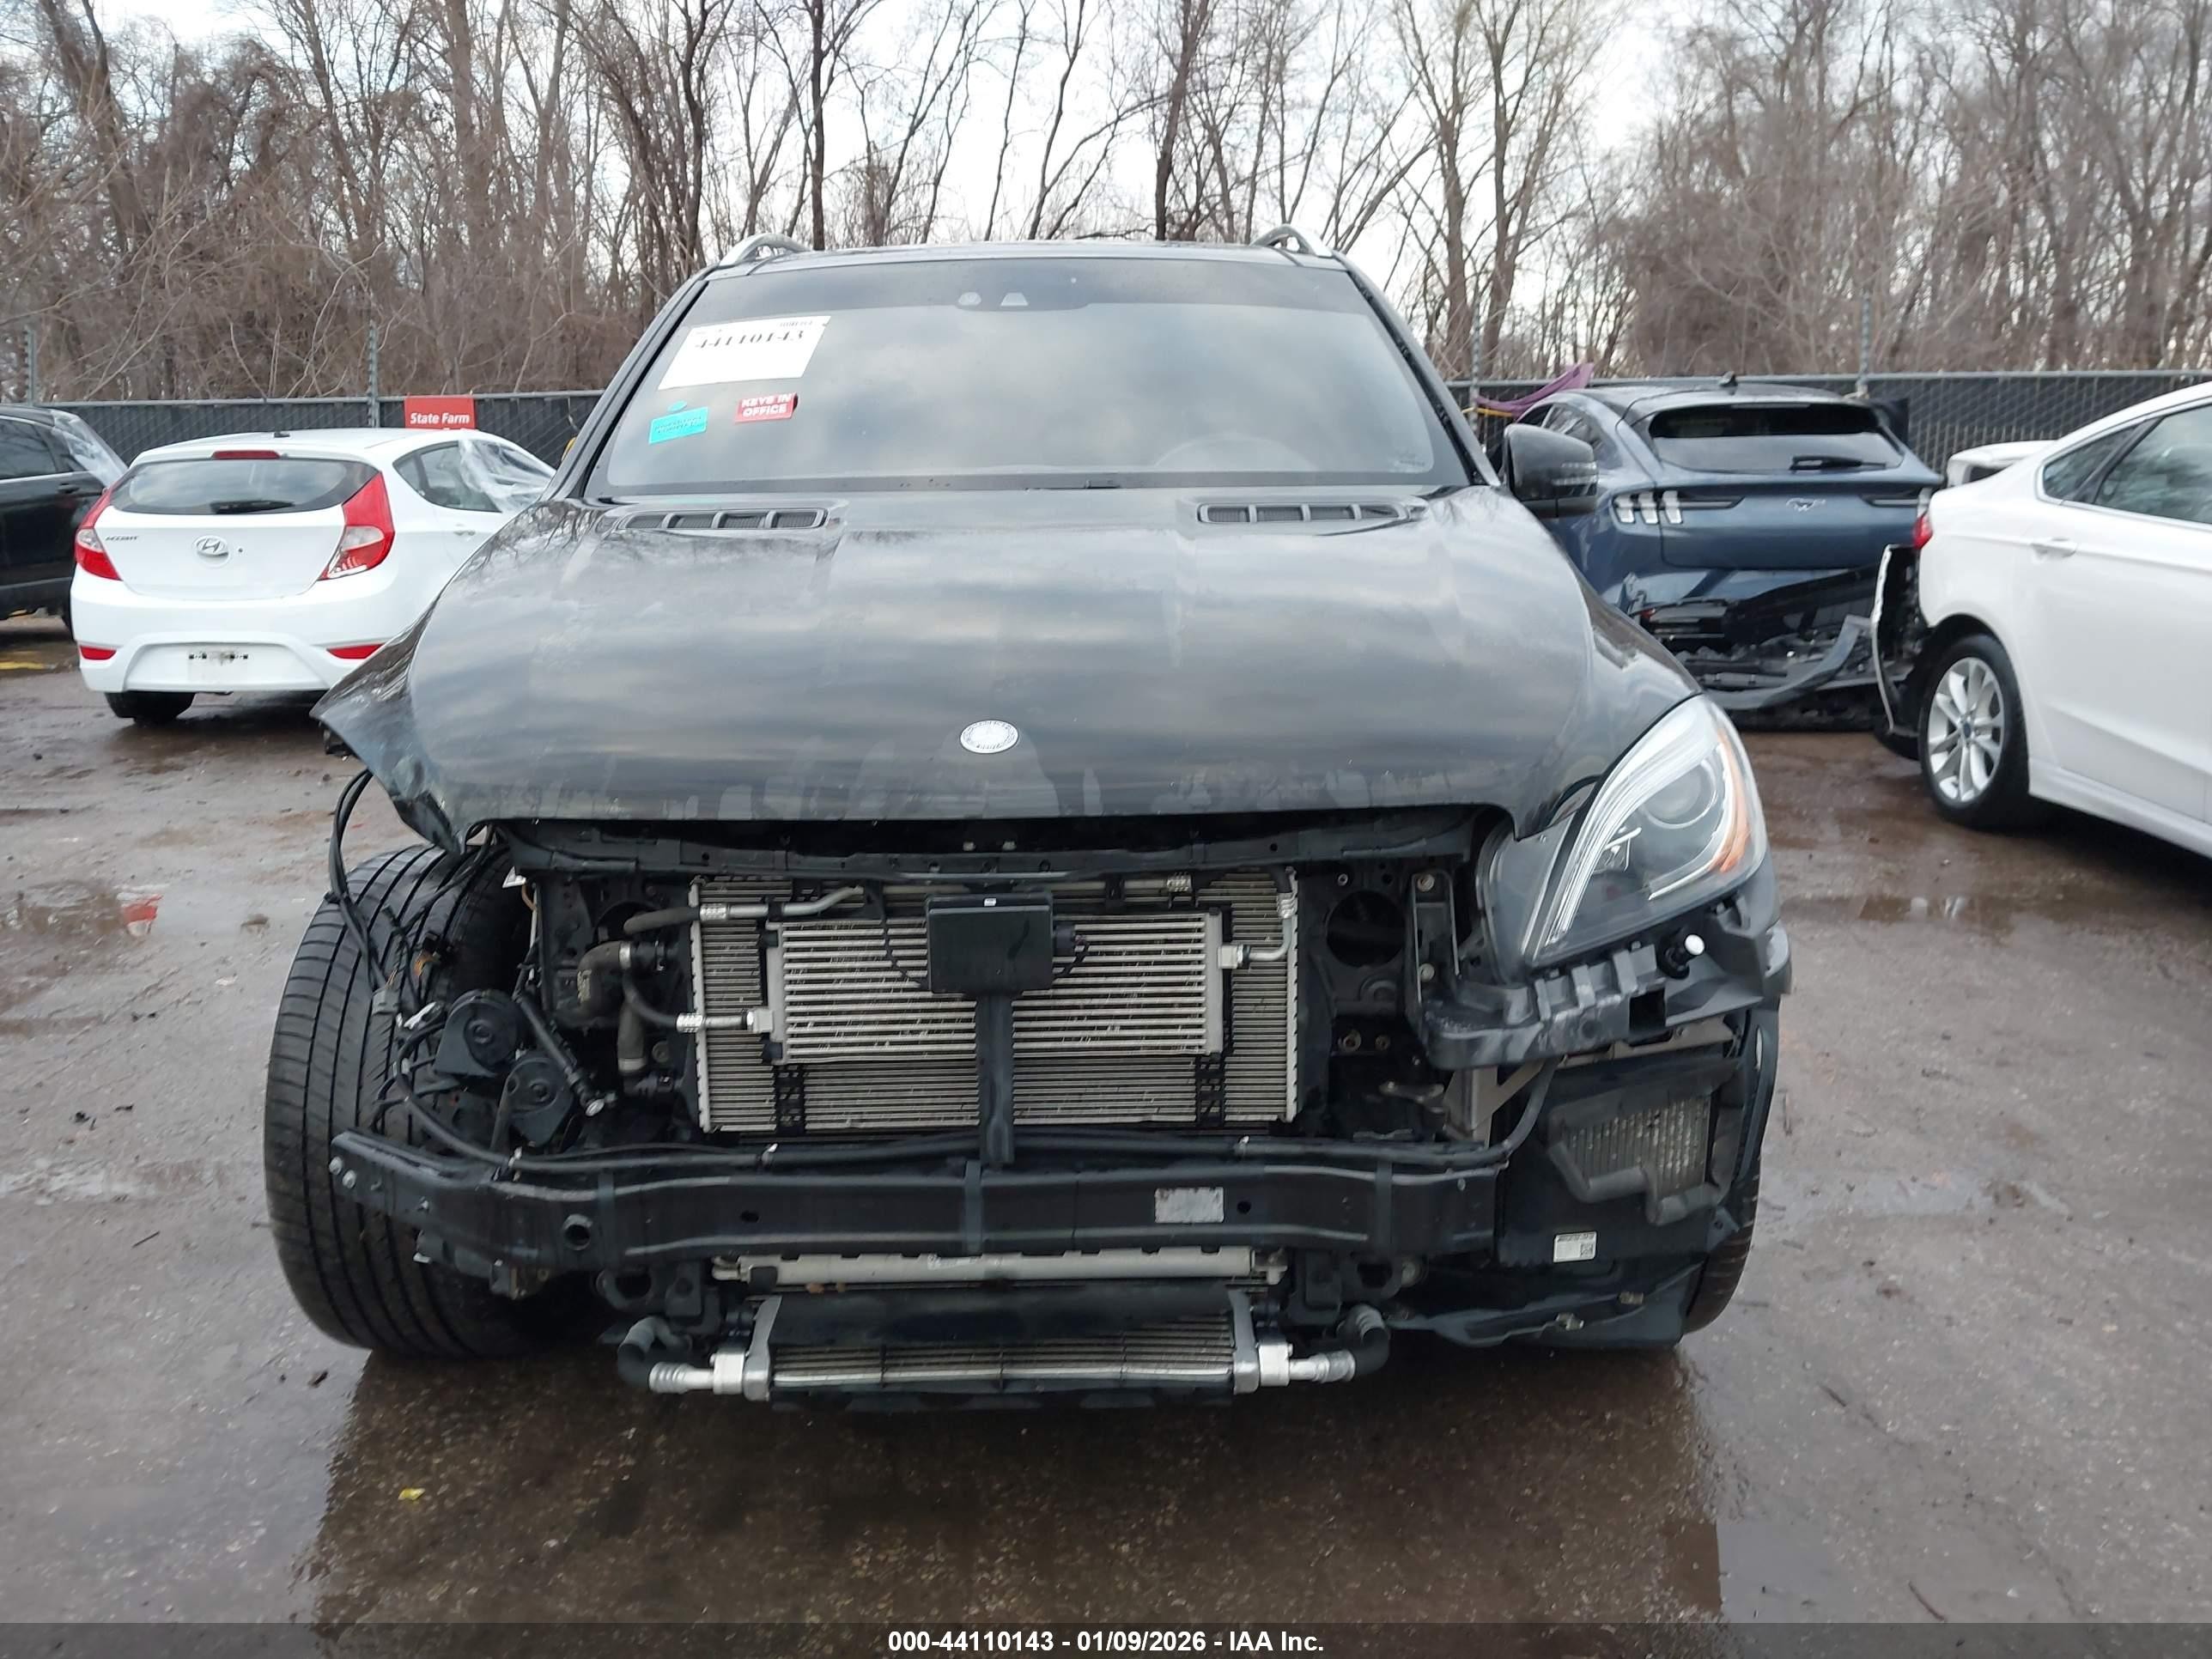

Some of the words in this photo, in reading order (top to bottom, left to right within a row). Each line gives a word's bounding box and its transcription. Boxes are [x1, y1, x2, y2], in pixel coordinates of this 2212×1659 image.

[776, 392, 793, 404] IN
[742, 404, 787, 417] OFFICE
[410, 412, 440, 424] State
[441, 412, 470, 424] Farm
